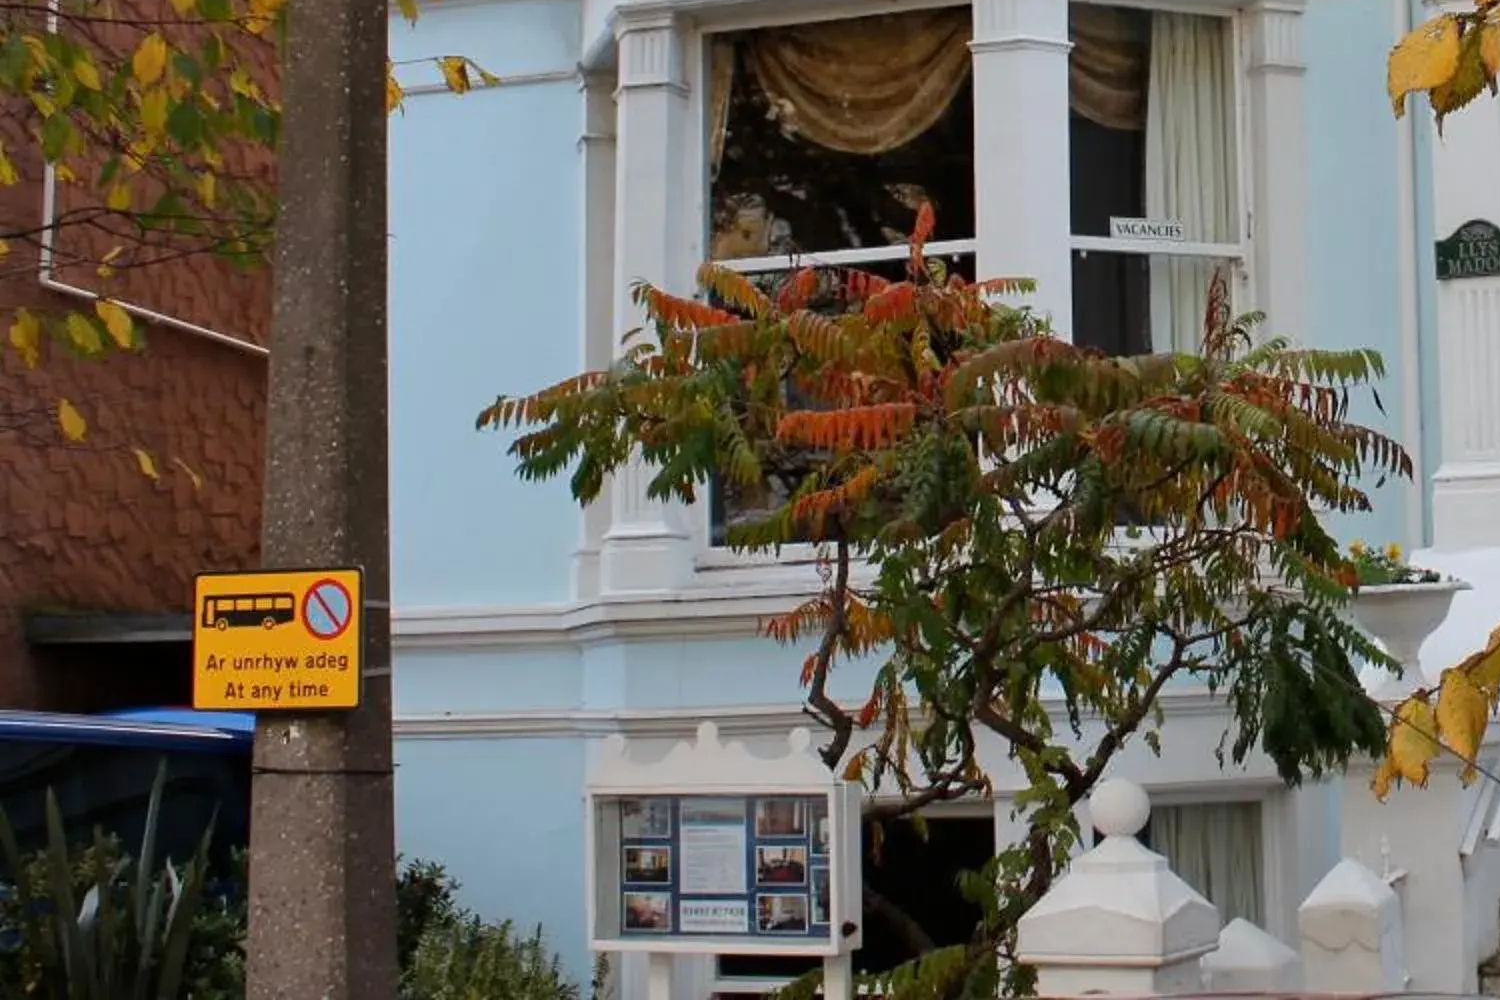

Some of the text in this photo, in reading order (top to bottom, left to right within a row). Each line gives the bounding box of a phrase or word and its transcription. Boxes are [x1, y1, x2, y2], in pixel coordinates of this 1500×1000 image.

[1116, 223, 1181, 237] VACANCIES
[1459, 240, 1499, 258] LLYS
[206, 652, 348, 672] Ar unrhyw adeg
[224, 682, 328, 700] At any time
